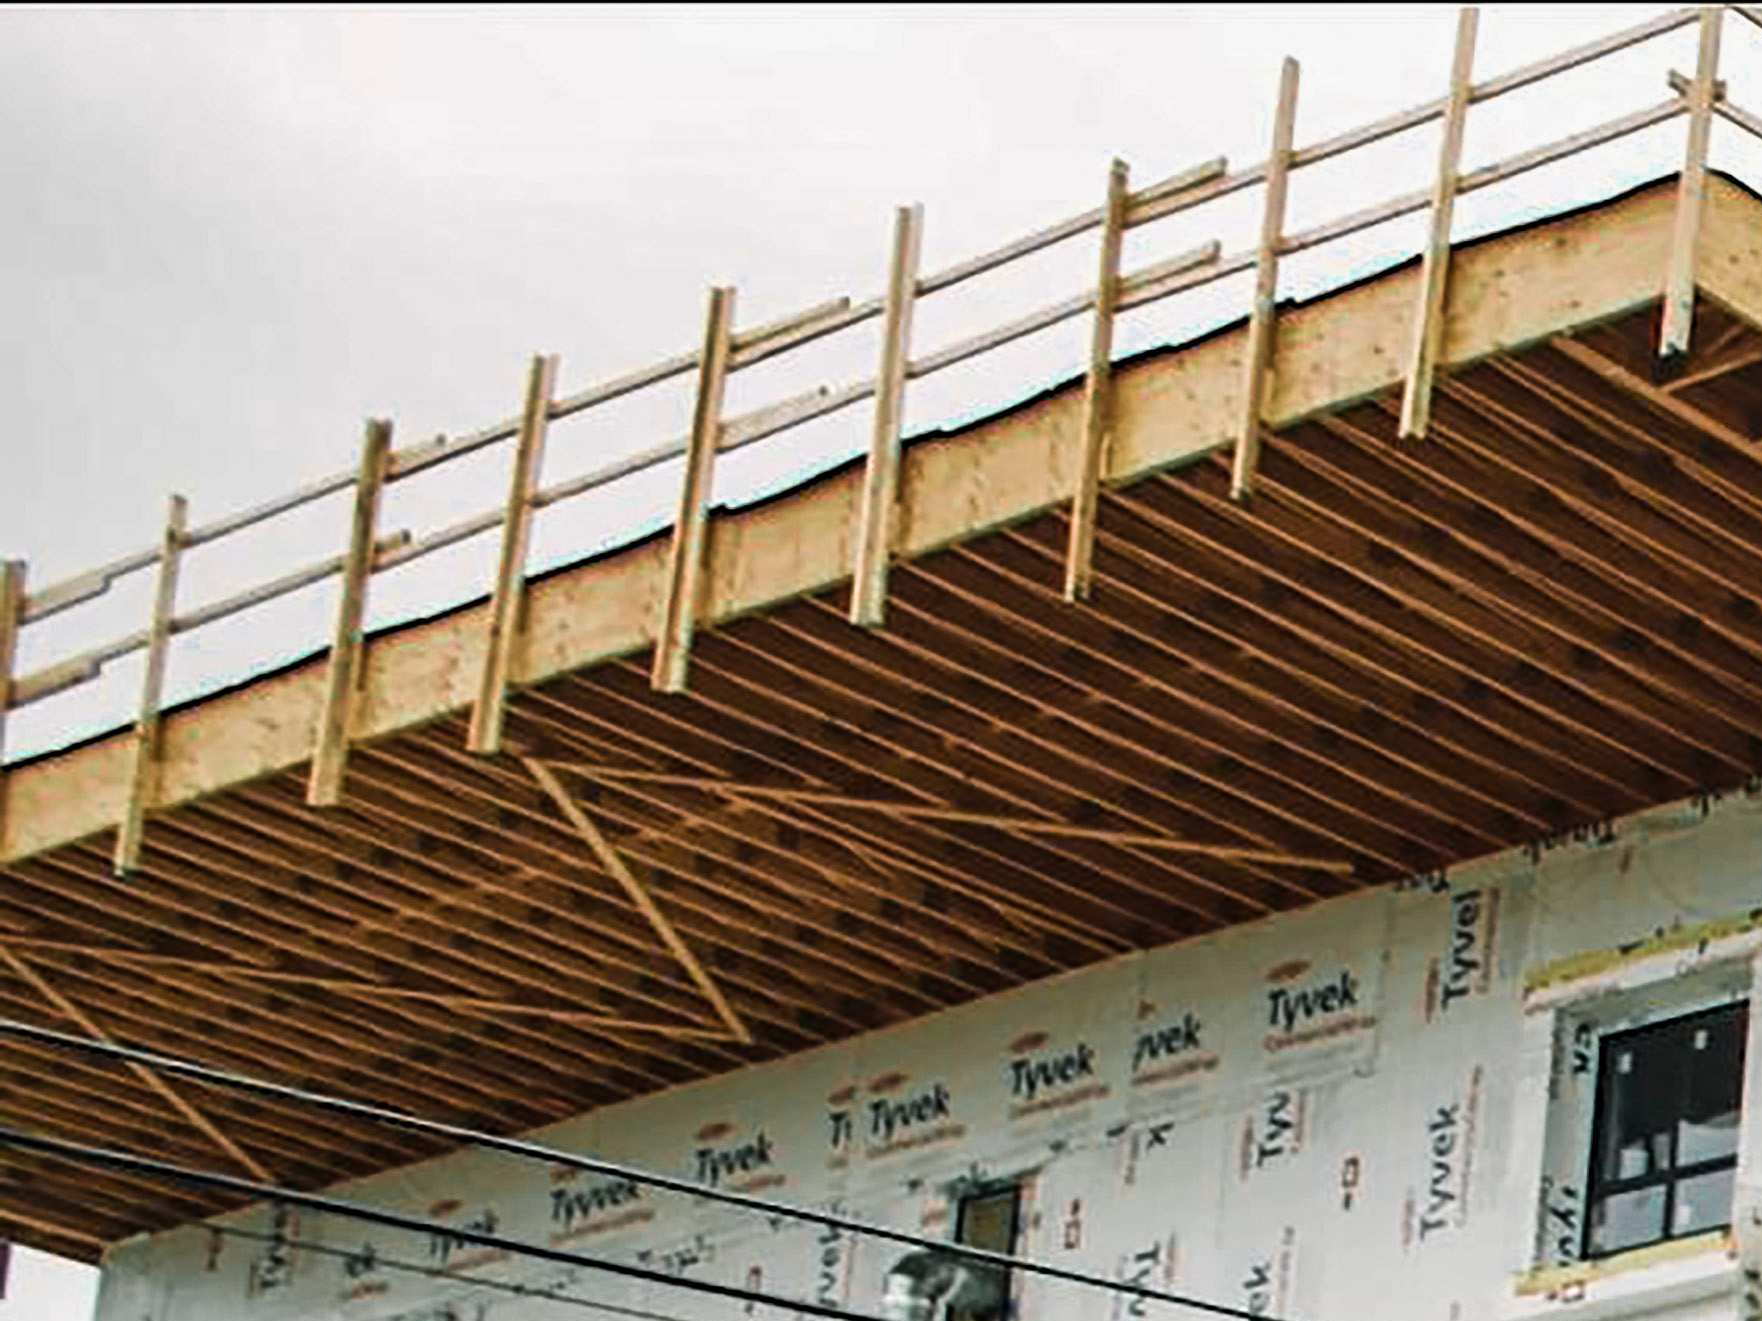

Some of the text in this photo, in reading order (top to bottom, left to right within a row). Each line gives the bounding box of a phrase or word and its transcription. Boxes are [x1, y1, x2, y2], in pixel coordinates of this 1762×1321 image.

[1267, 969, 1359, 1032] Tyvek
[1009, 1041, 1095, 1099] Tyvek
[869, 1083, 950, 1138] Tyvek
[695, 1130, 774, 1190] Tyvek
[1421, 1103, 1460, 1241] Tyvek
